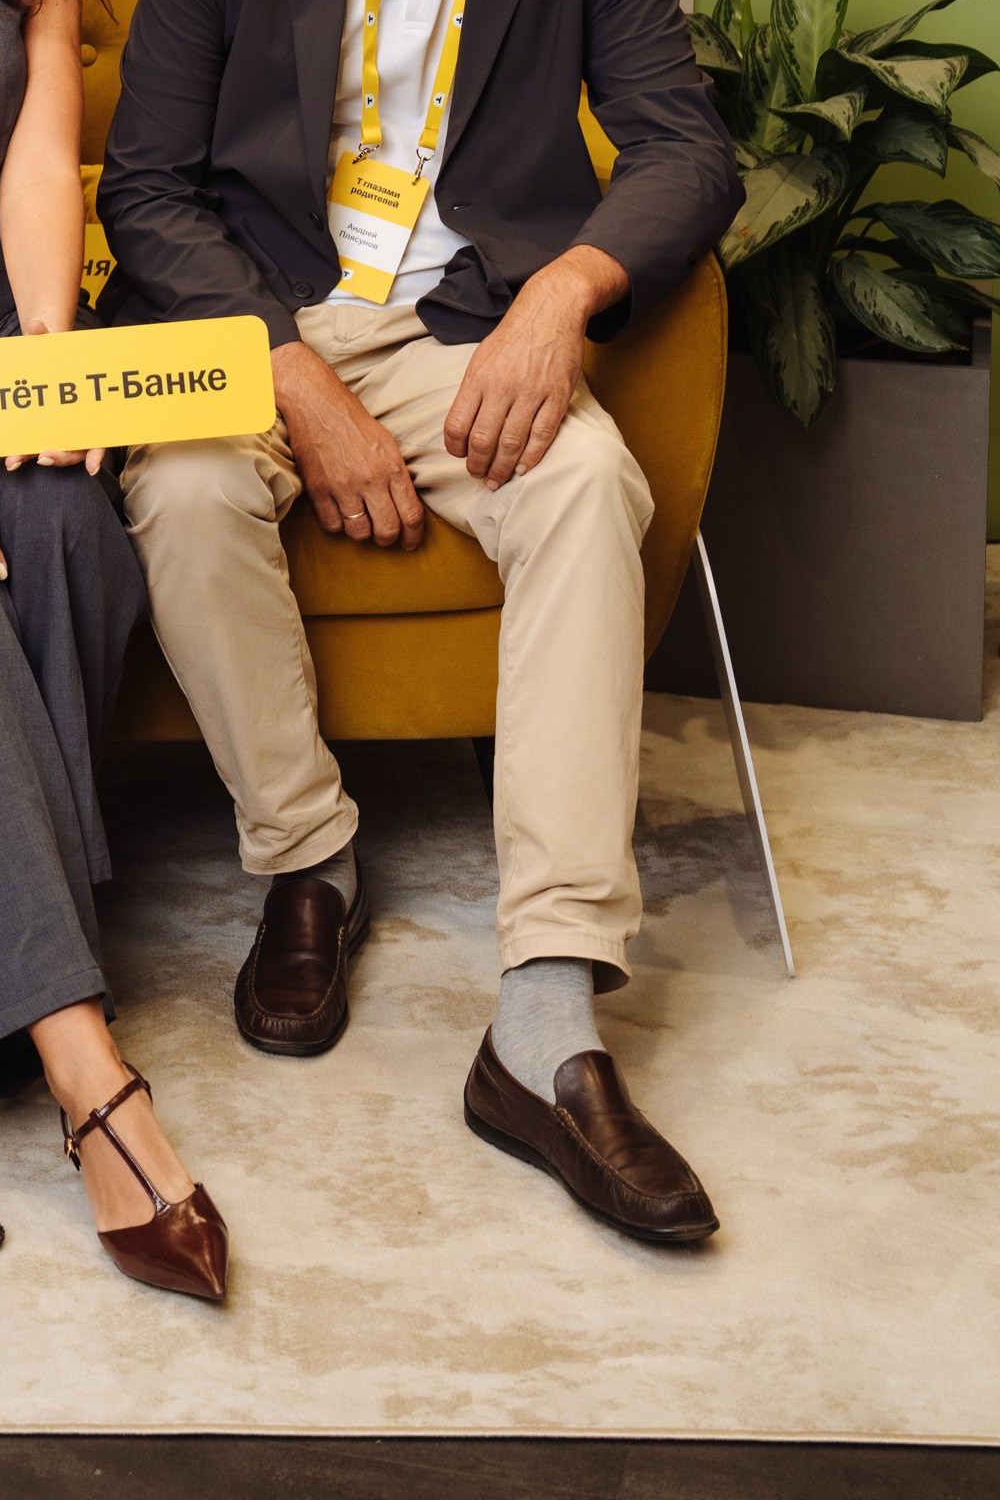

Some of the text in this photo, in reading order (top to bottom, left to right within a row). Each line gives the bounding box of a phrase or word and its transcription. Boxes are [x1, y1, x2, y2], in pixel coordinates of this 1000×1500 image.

[350, 186, 399, 208] родителей
[357, 177, 400, 199] Т глазами
[347, 222, 378, 239] Андрей
[58, 382, 79, 405] в
[85, 367, 227, 402] Т-Банке
